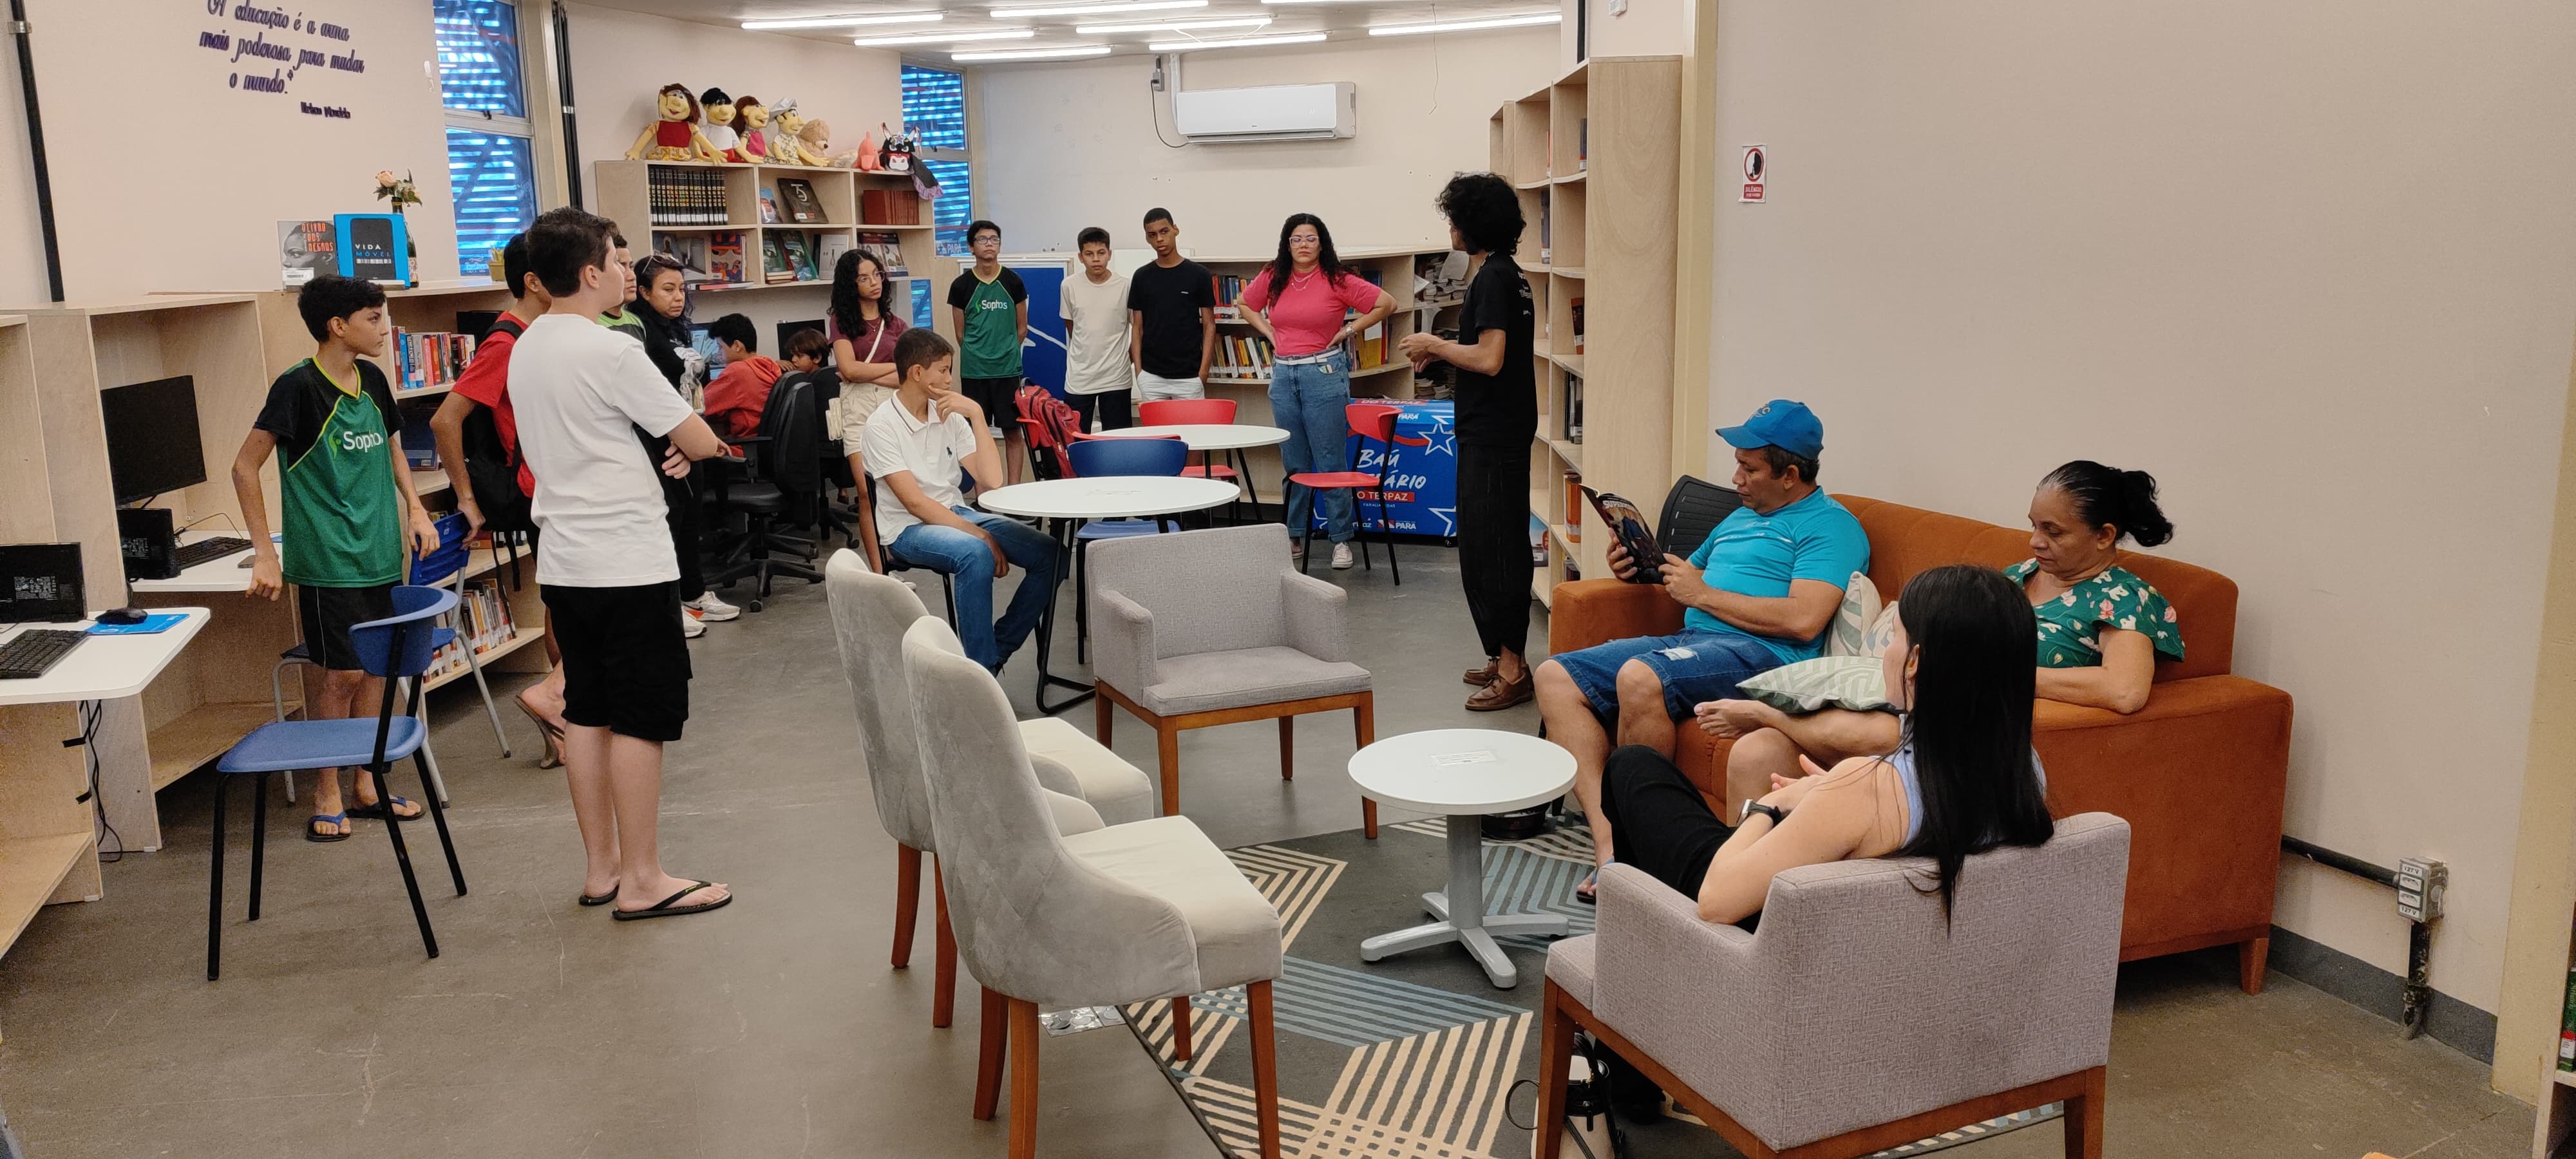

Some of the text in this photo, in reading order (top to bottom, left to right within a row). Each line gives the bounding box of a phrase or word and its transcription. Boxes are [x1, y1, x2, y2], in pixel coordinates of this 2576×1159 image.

[234, 0, 290, 29] educação
[293, 12, 303, 31] é
[307, 20, 316, 34] a
[199, 29, 365, 73] mais poderosa para mudar
[229, 72, 238, 88] o
[981, 299, 1009, 311] Sophos
